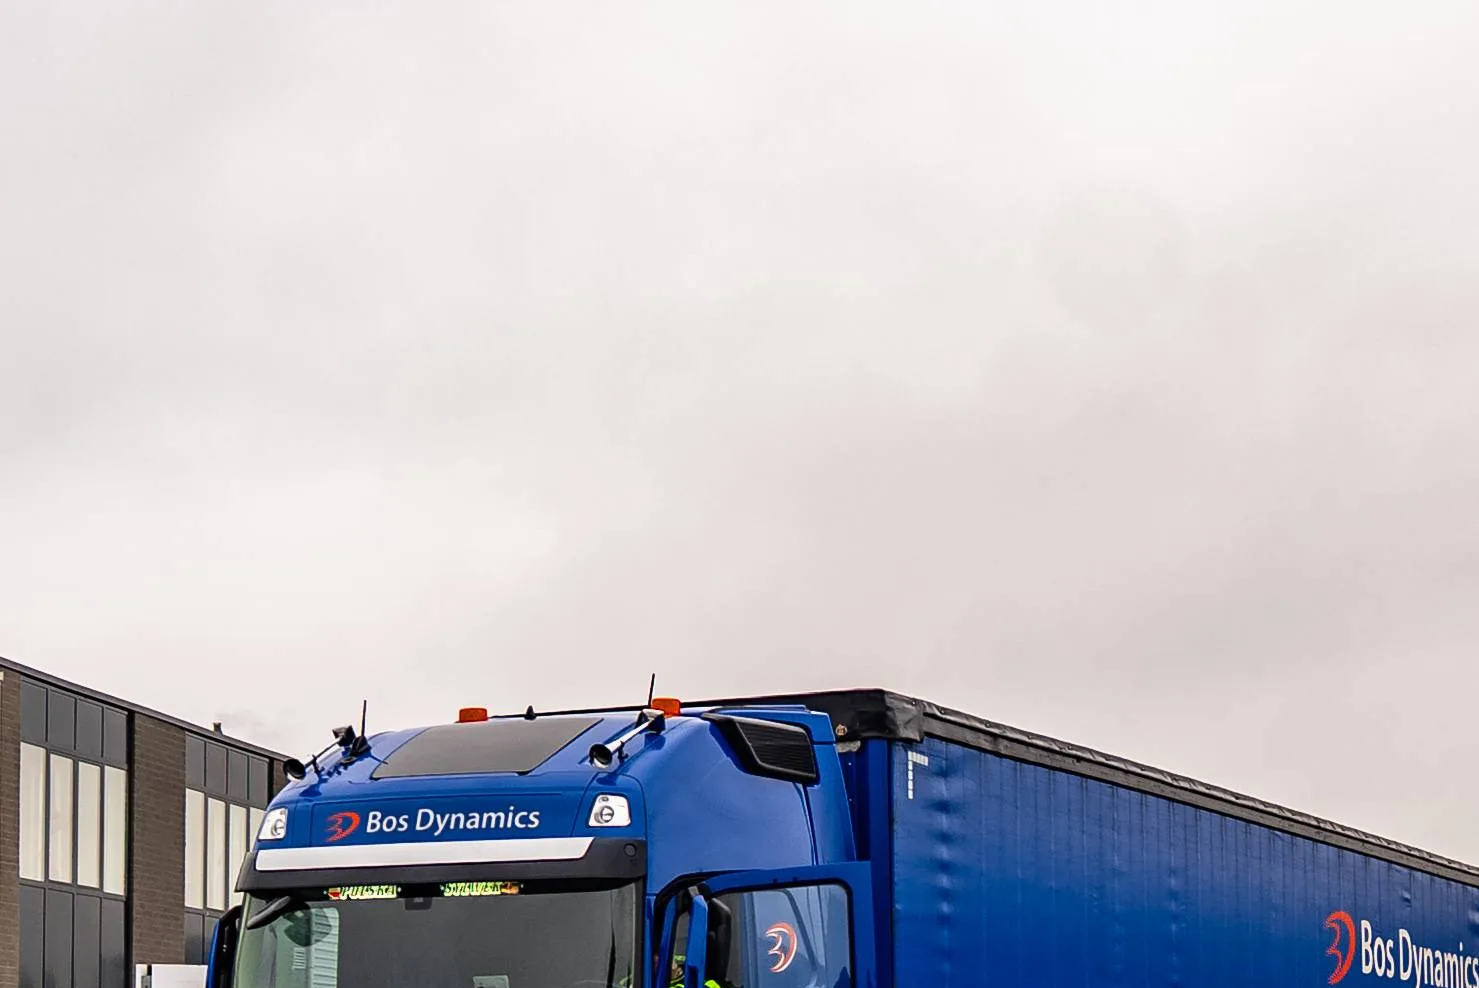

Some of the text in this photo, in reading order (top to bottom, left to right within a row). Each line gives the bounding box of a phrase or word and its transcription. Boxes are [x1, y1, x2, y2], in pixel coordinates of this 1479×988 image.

[366, 805, 540, 836] Bos Dynamics
[1360, 919, 1395, 979] Bos
